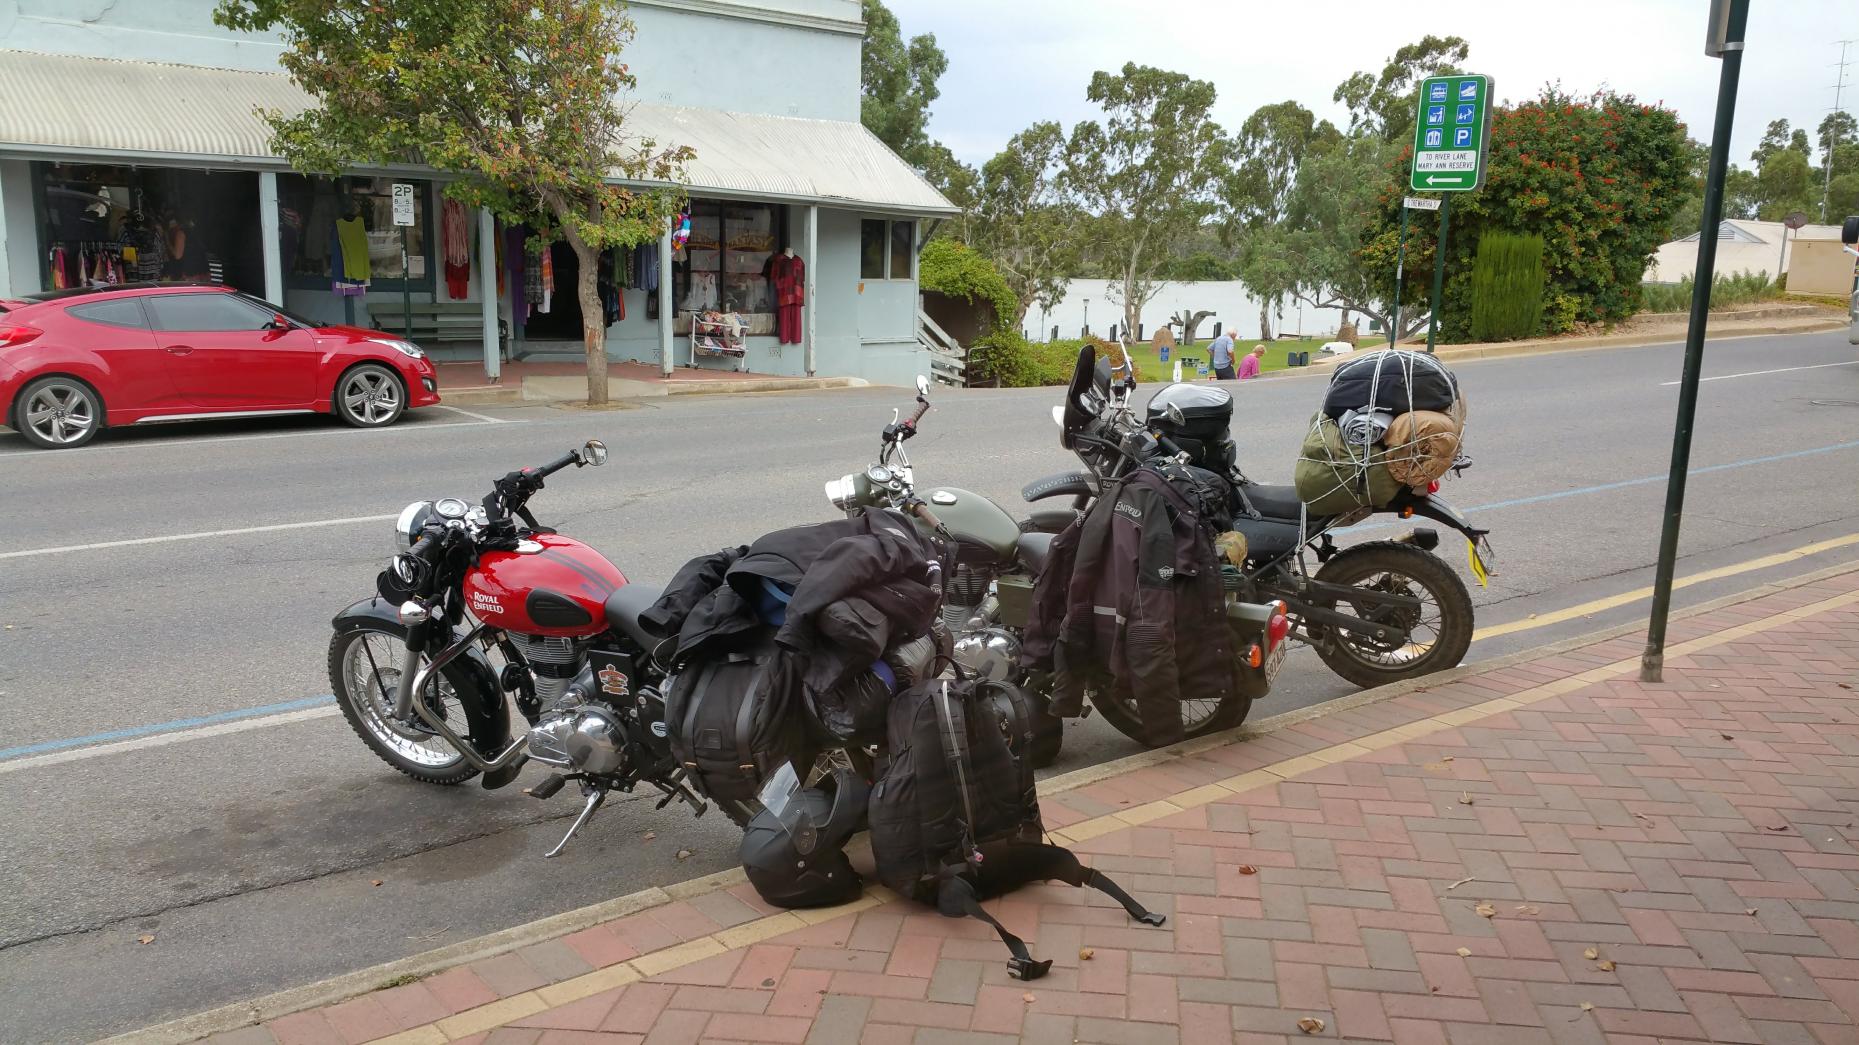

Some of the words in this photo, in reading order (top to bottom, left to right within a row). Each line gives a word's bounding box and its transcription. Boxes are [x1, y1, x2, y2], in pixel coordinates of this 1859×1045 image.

[1425, 153, 1433, 161] TO
[1434, 153, 1451, 161] RIVER
[1453, 152, 1467, 160] LANE
[1448, 161, 1474, 169] RESERVE
[394, 187, 411, 196] 2P
[474, 591, 499, 603] ROYAL
[474, 601, 504, 613] ENFIELD
